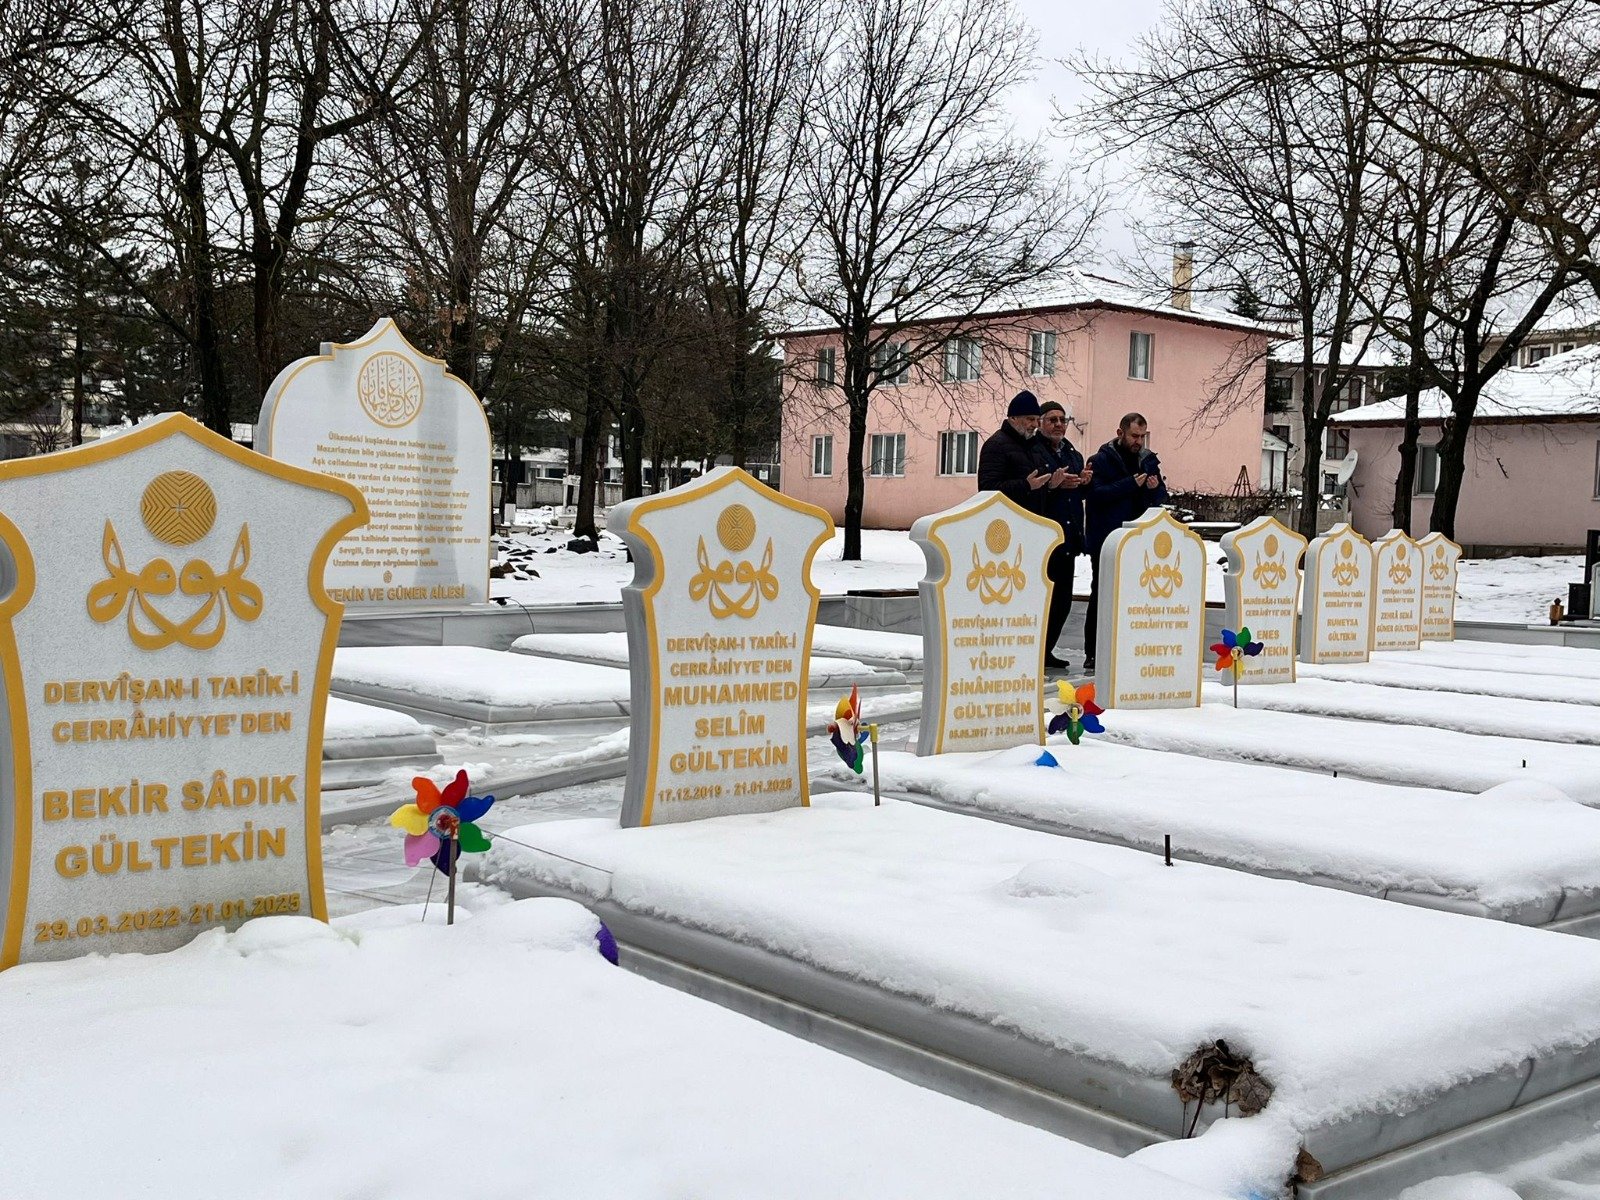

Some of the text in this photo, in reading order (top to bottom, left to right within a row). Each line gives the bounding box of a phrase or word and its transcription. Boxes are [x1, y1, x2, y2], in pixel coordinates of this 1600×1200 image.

[312, 457, 326, 466] Aşk
[321, 470, 346, 479] Yktan
[326, 584, 466, 602] TEKİN VE GÜNER AİLESİ
[1256, 630, 1280, 640] ENES
[968, 650, 1016, 671] YÛSUF
[1134, 643, 1183, 657] SÜMEYYE
[1260, 643, 1289, 657] TEKİN
[1140, 663, 1175, 678] GÜNER
[208, 667, 300, 698] TARÎK-İ
[664, 681, 798, 706] MUHAMMED
[953, 698, 1032, 720] GÜLTEKİN
[694, 708, 766, 738] SELÎM
[669, 739, 789, 774] GÜLTEKİN
[42, 769, 298, 822] BEKİR SÂDIK
[54, 820, 287, 879] GÜLTEKİN
